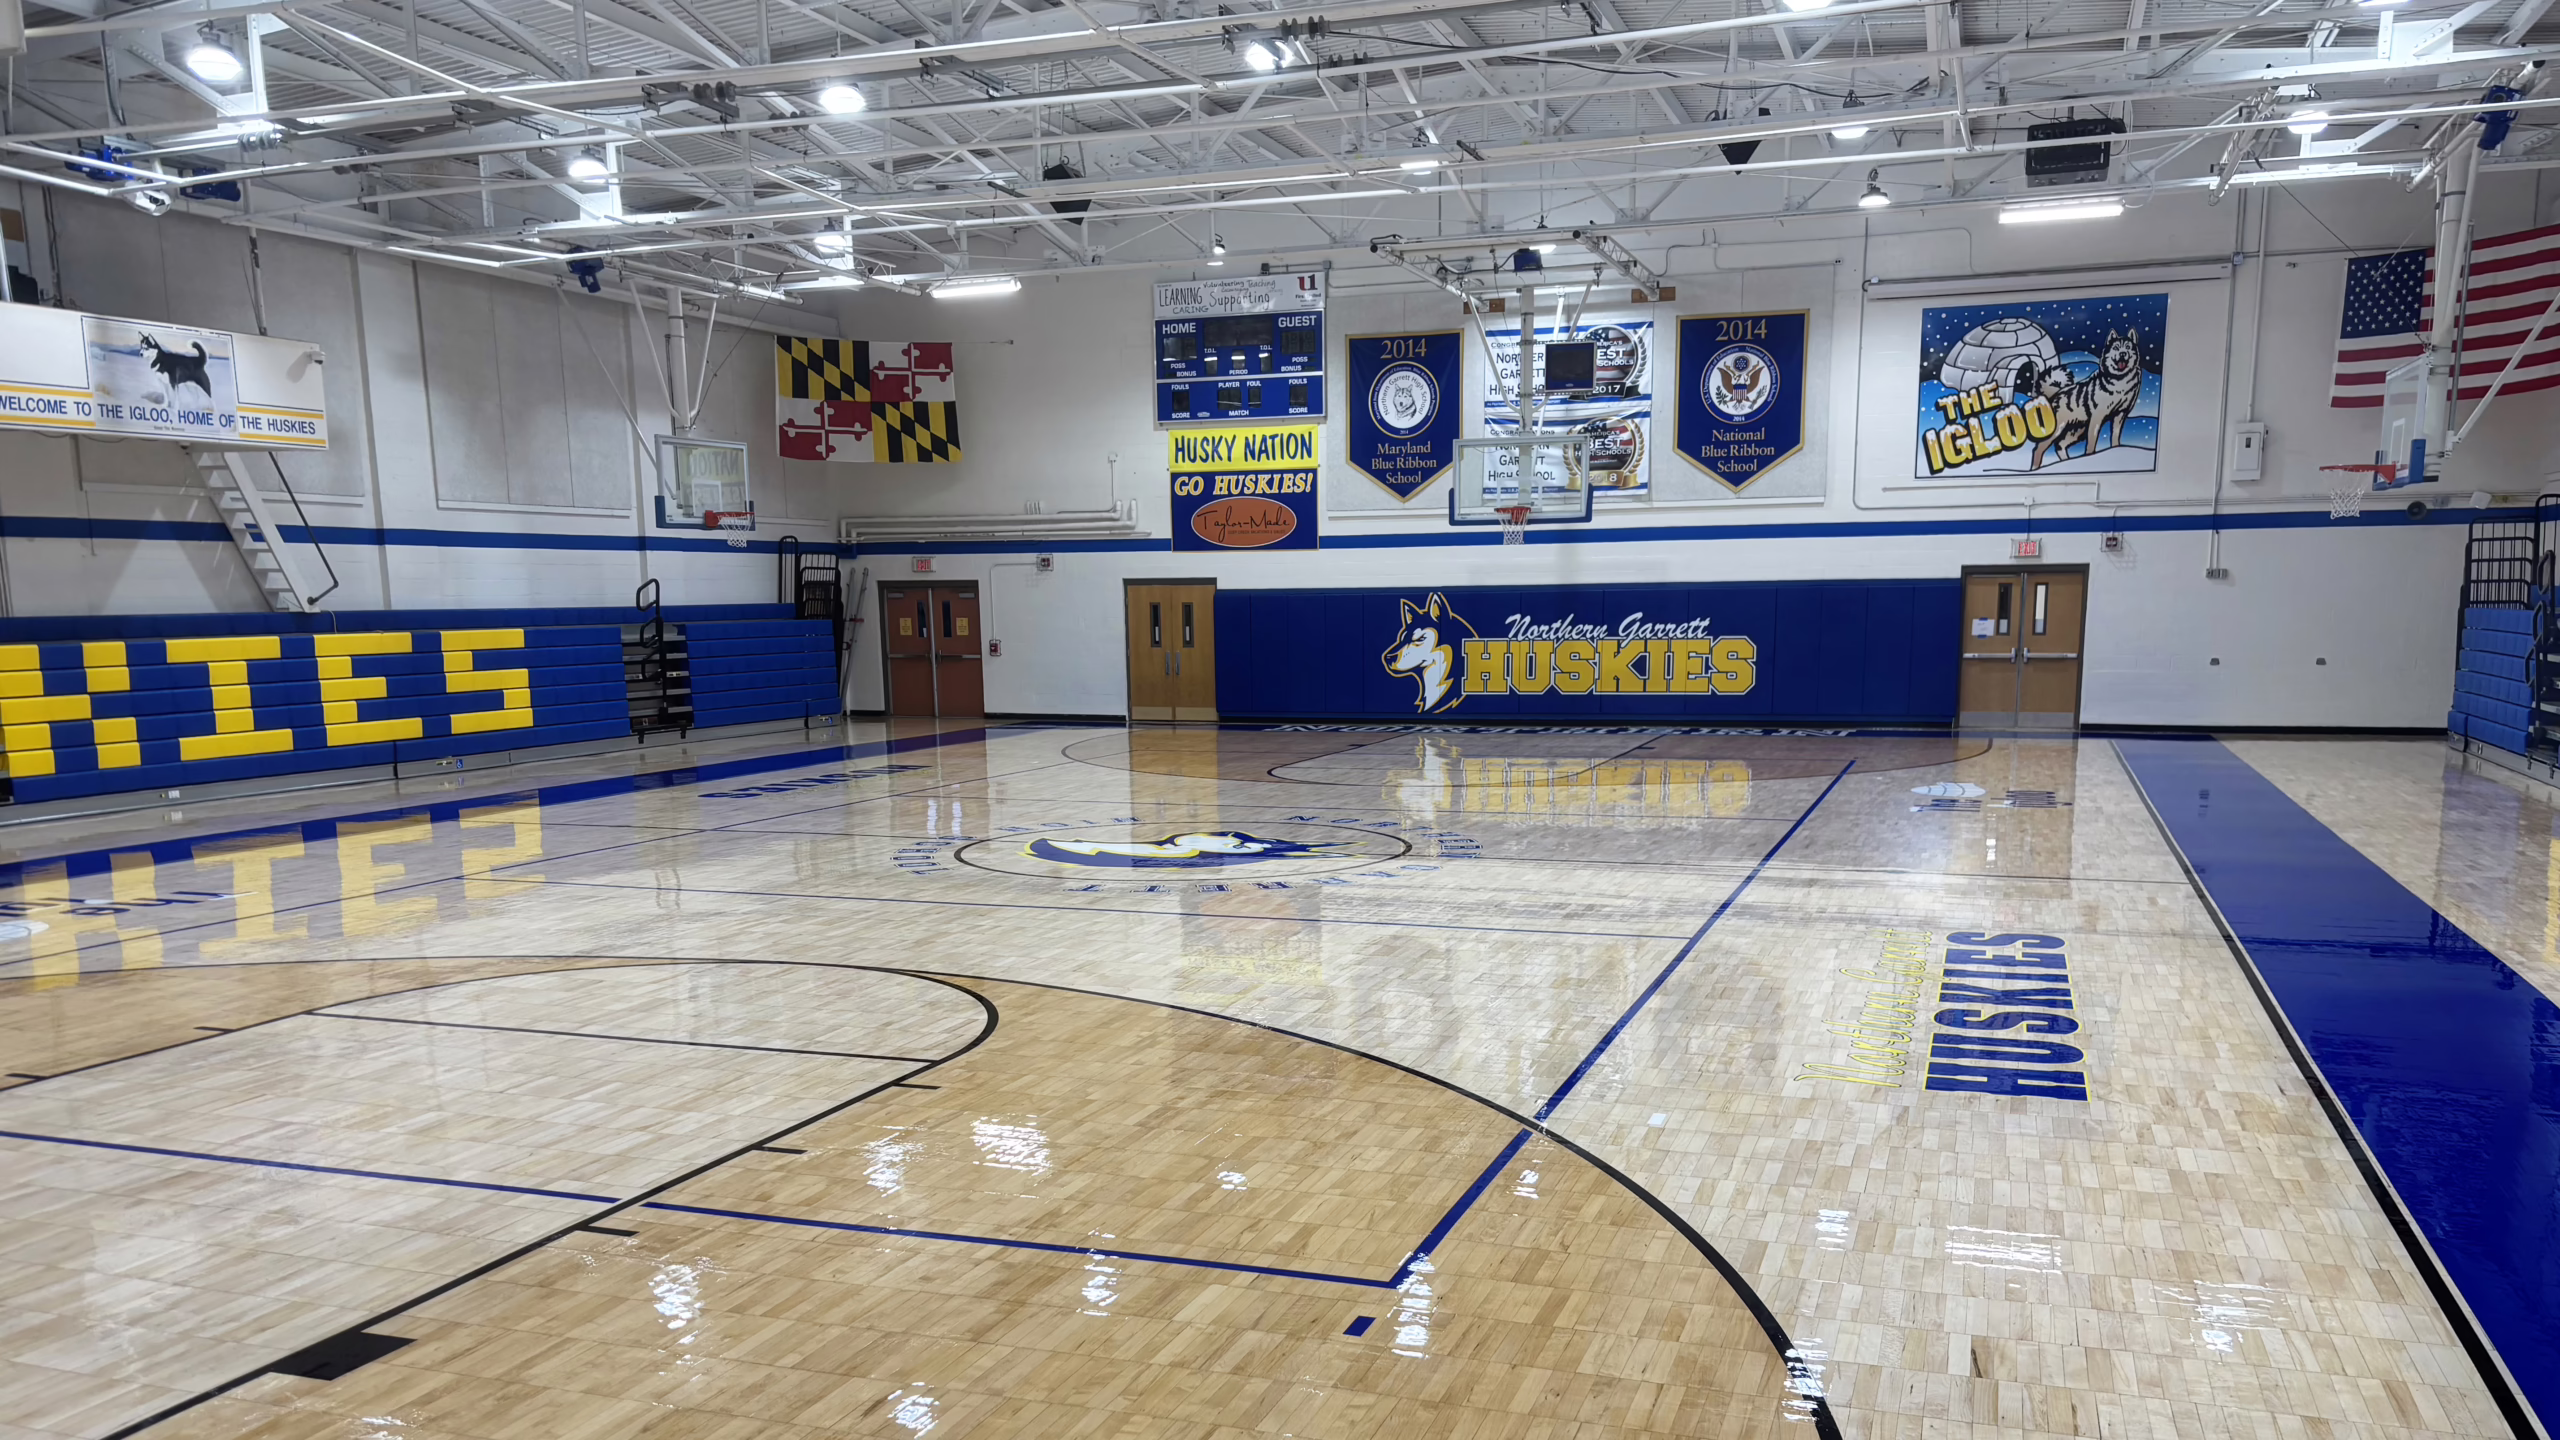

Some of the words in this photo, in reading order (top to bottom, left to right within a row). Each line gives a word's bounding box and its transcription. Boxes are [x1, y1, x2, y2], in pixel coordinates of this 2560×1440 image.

[1247, 279, 1276, 290] Teaching
[1159, 287, 1202, 307] LEARNING
[1209, 290, 1271, 312] Supporting
[1172, 305, 1209, 315] CARING
[1162, 322, 1197, 335] HOME
[1278, 315, 1317, 328] GUEST
[1715, 319, 1768, 341] 2014
[1380, 338, 1427, 359] 2014
[1381, 385, 1390, 416] Northern
[1389, 375, 1411, 386] Garrett
[1411, 376, 1424, 391] High
[1418, 391, 1428, 415] School
[1593, 384, 1621, 394] 2017
[1936, 380, 2003, 424] THE
[74, 401, 92, 418] TO
[97, 404, 124, 419] THE
[129, 406, 174, 425] IGLOO,
[178, 410, 214, 427] HOME
[219, 414, 235, 428] OF
[239, 415, 263, 431] THE
[267, 418, 316, 435] HUSKIES
[1712, 427, 1765, 442] National
[1922, 395, 2058, 475] IGLOO
[1174, 434, 1237, 464] HUSKY
[1244, 431, 1312, 462] NATION
[1377, 441, 1431, 457] Maryland
[1596, 448, 1632, 456] SCHOOLS
[1701, 445, 1728, 457] Blue
[1729, 443, 1775, 457] Ribbon
[1371, 457, 1395, 470] Blue
[1396, 457, 1437, 469] Ribbon
[1717, 461, 1758, 473] School
[1174, 476, 1205, 496] GO
[1213, 473, 1314, 495] HUSKIES!
[1385, 471, 1422, 484] School
[1196, 505, 1290, 543] Taylor-Made
[1505, 612, 1609, 642] Northern
[1617, 611, 1711, 648] Garrett
[1461, 637, 1757, 695] HUSKIES
[697, 764, 933, 799] HUSKIES
[1923, 931, 2092, 1102] HUSKIES
